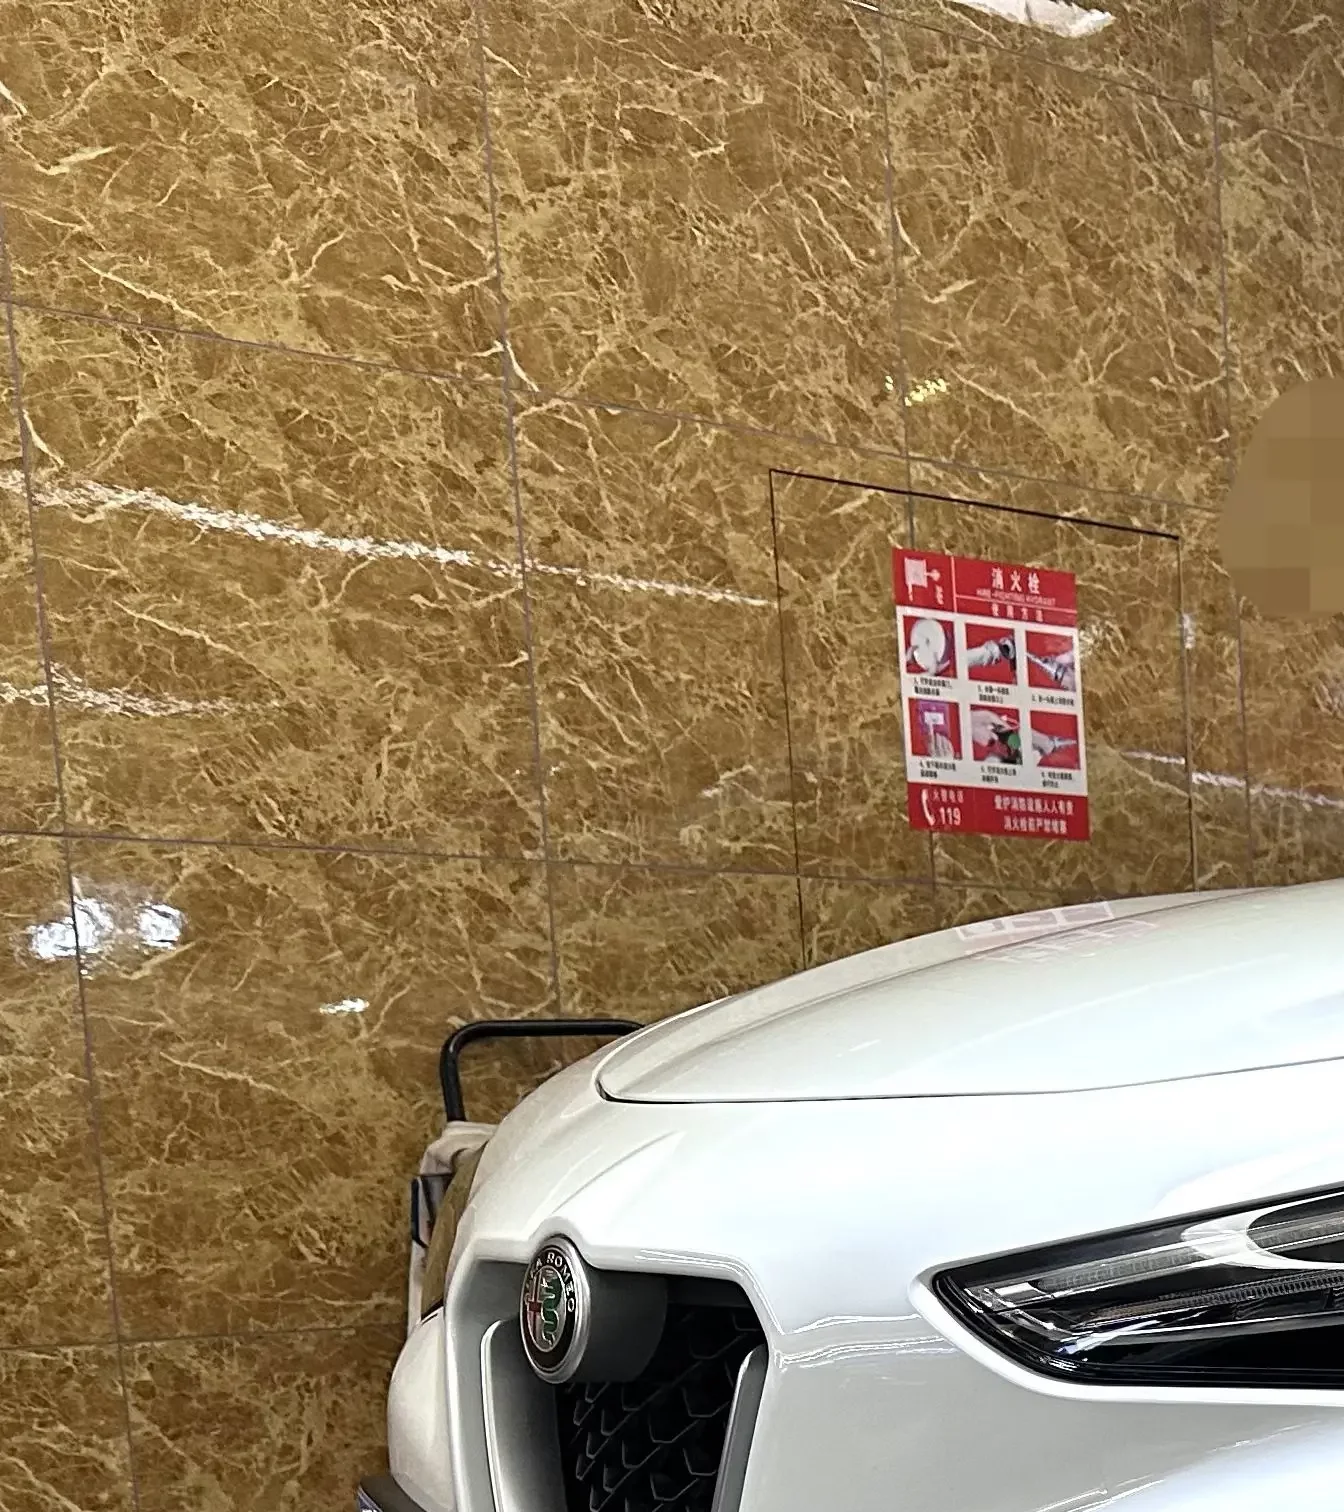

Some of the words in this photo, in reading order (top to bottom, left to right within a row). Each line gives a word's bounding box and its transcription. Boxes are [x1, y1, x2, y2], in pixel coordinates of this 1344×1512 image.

[991, 567, 1040, 595] 消火栓
[940, 806, 961, 826] 119
[546, 1251, 576, 1313] ROMEO
